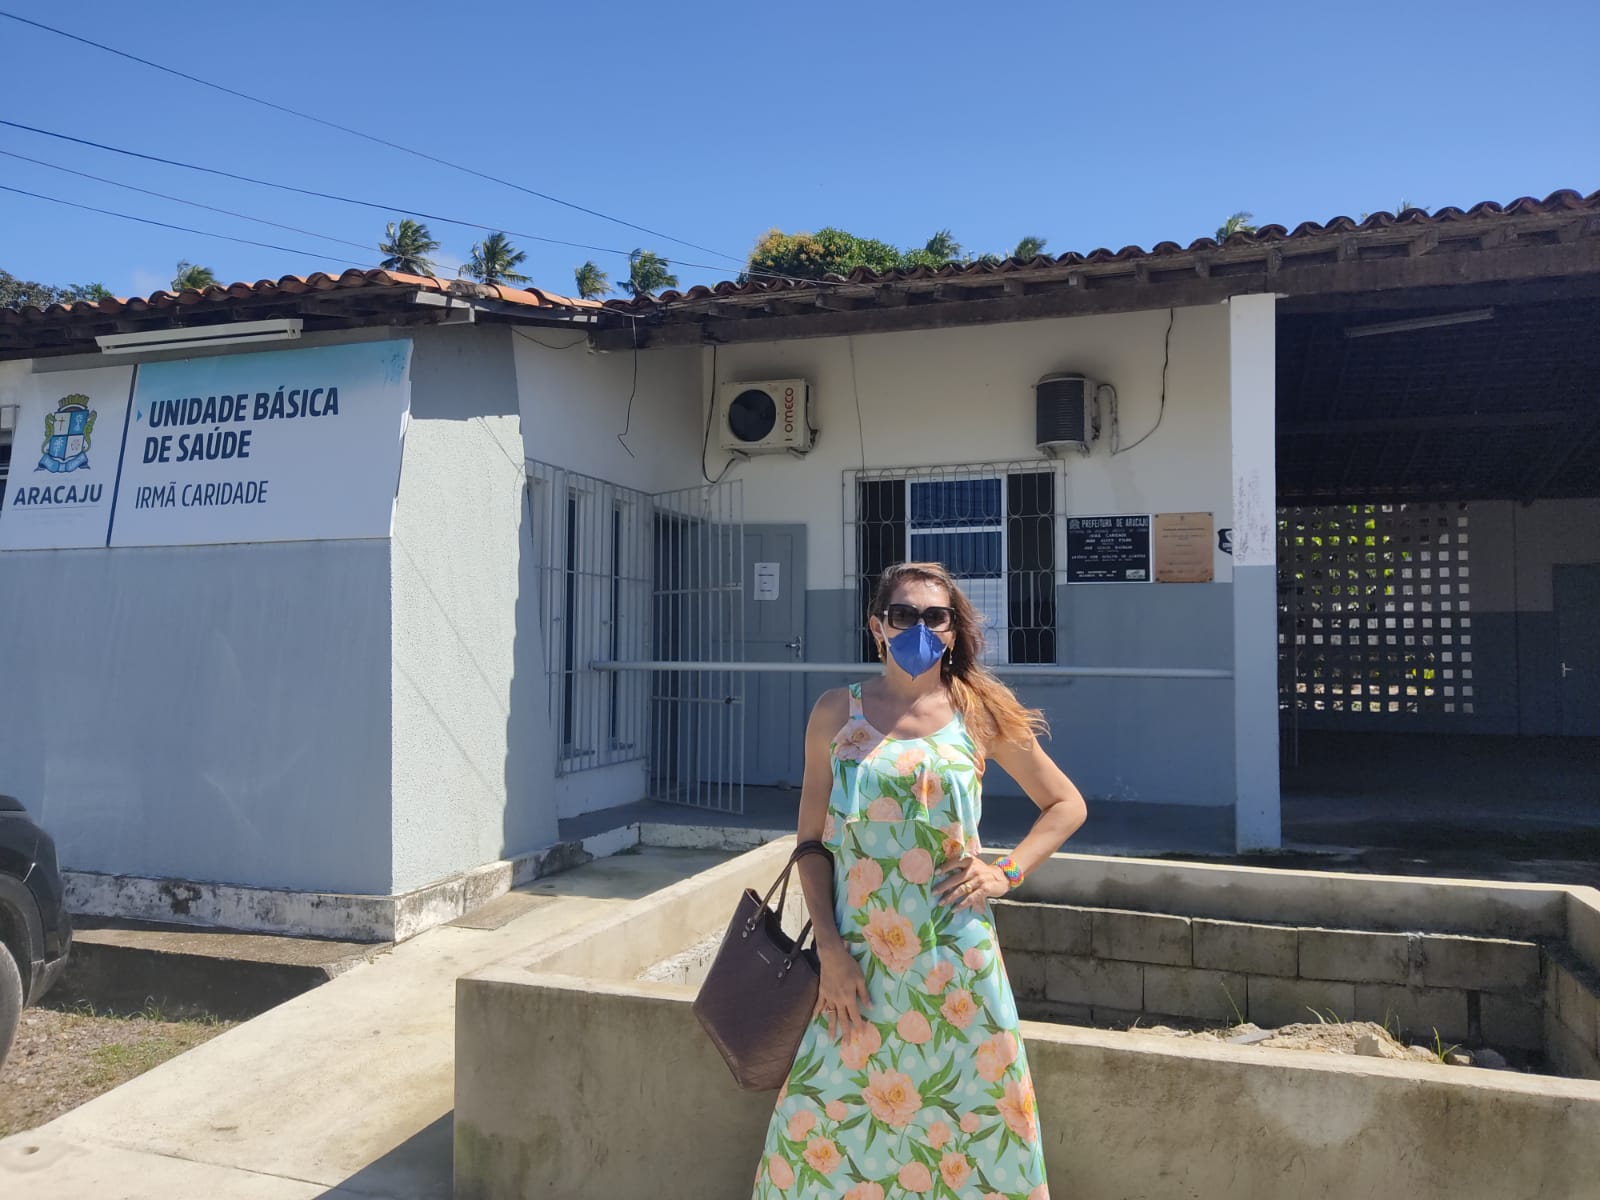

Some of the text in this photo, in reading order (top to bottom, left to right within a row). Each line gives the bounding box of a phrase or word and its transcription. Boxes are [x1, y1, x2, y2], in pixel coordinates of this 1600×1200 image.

[149, 385, 339, 427] UNIDADE BÁSICA
[143, 427, 252, 464] DE SAÚDE
[13, 484, 103, 506] ARACAJU
[135, 480, 269, 509] IRMÃ CARIDADE
